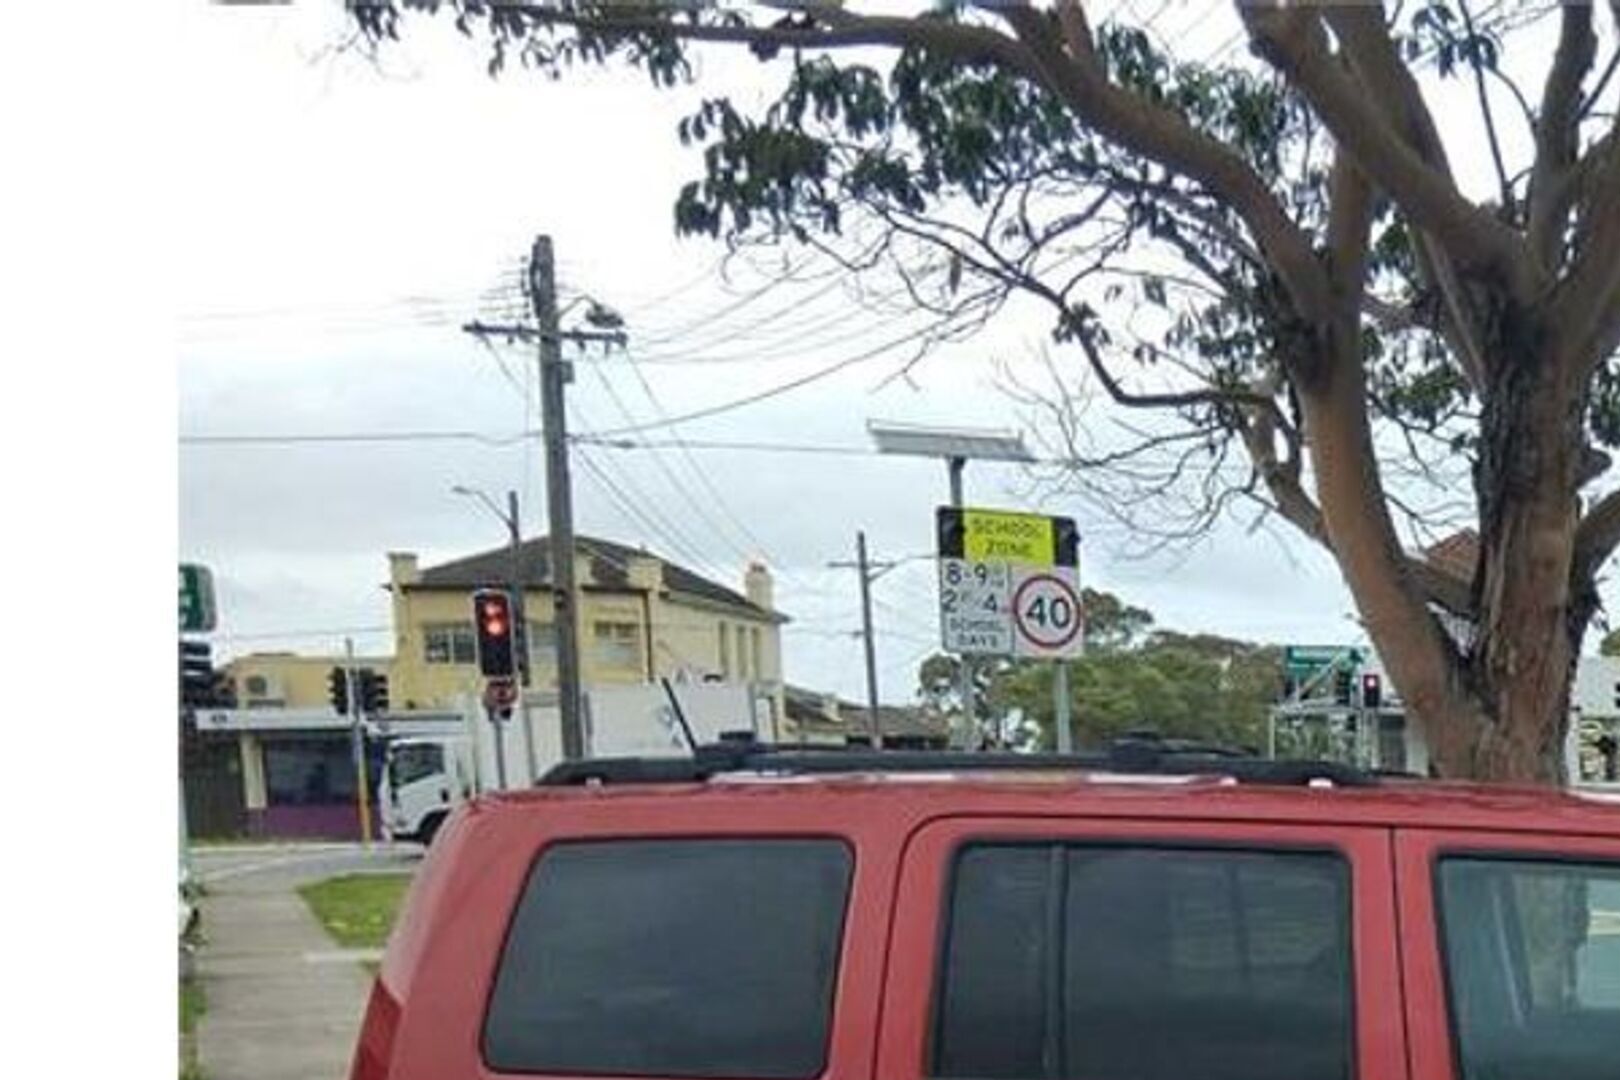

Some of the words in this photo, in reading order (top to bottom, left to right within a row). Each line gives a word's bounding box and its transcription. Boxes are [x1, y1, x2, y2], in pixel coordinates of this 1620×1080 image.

[971, 517, 1047, 539] SCHOOL
[984, 538, 1034, 559] ZONE
[1025, 595, 1071, 629] 40
